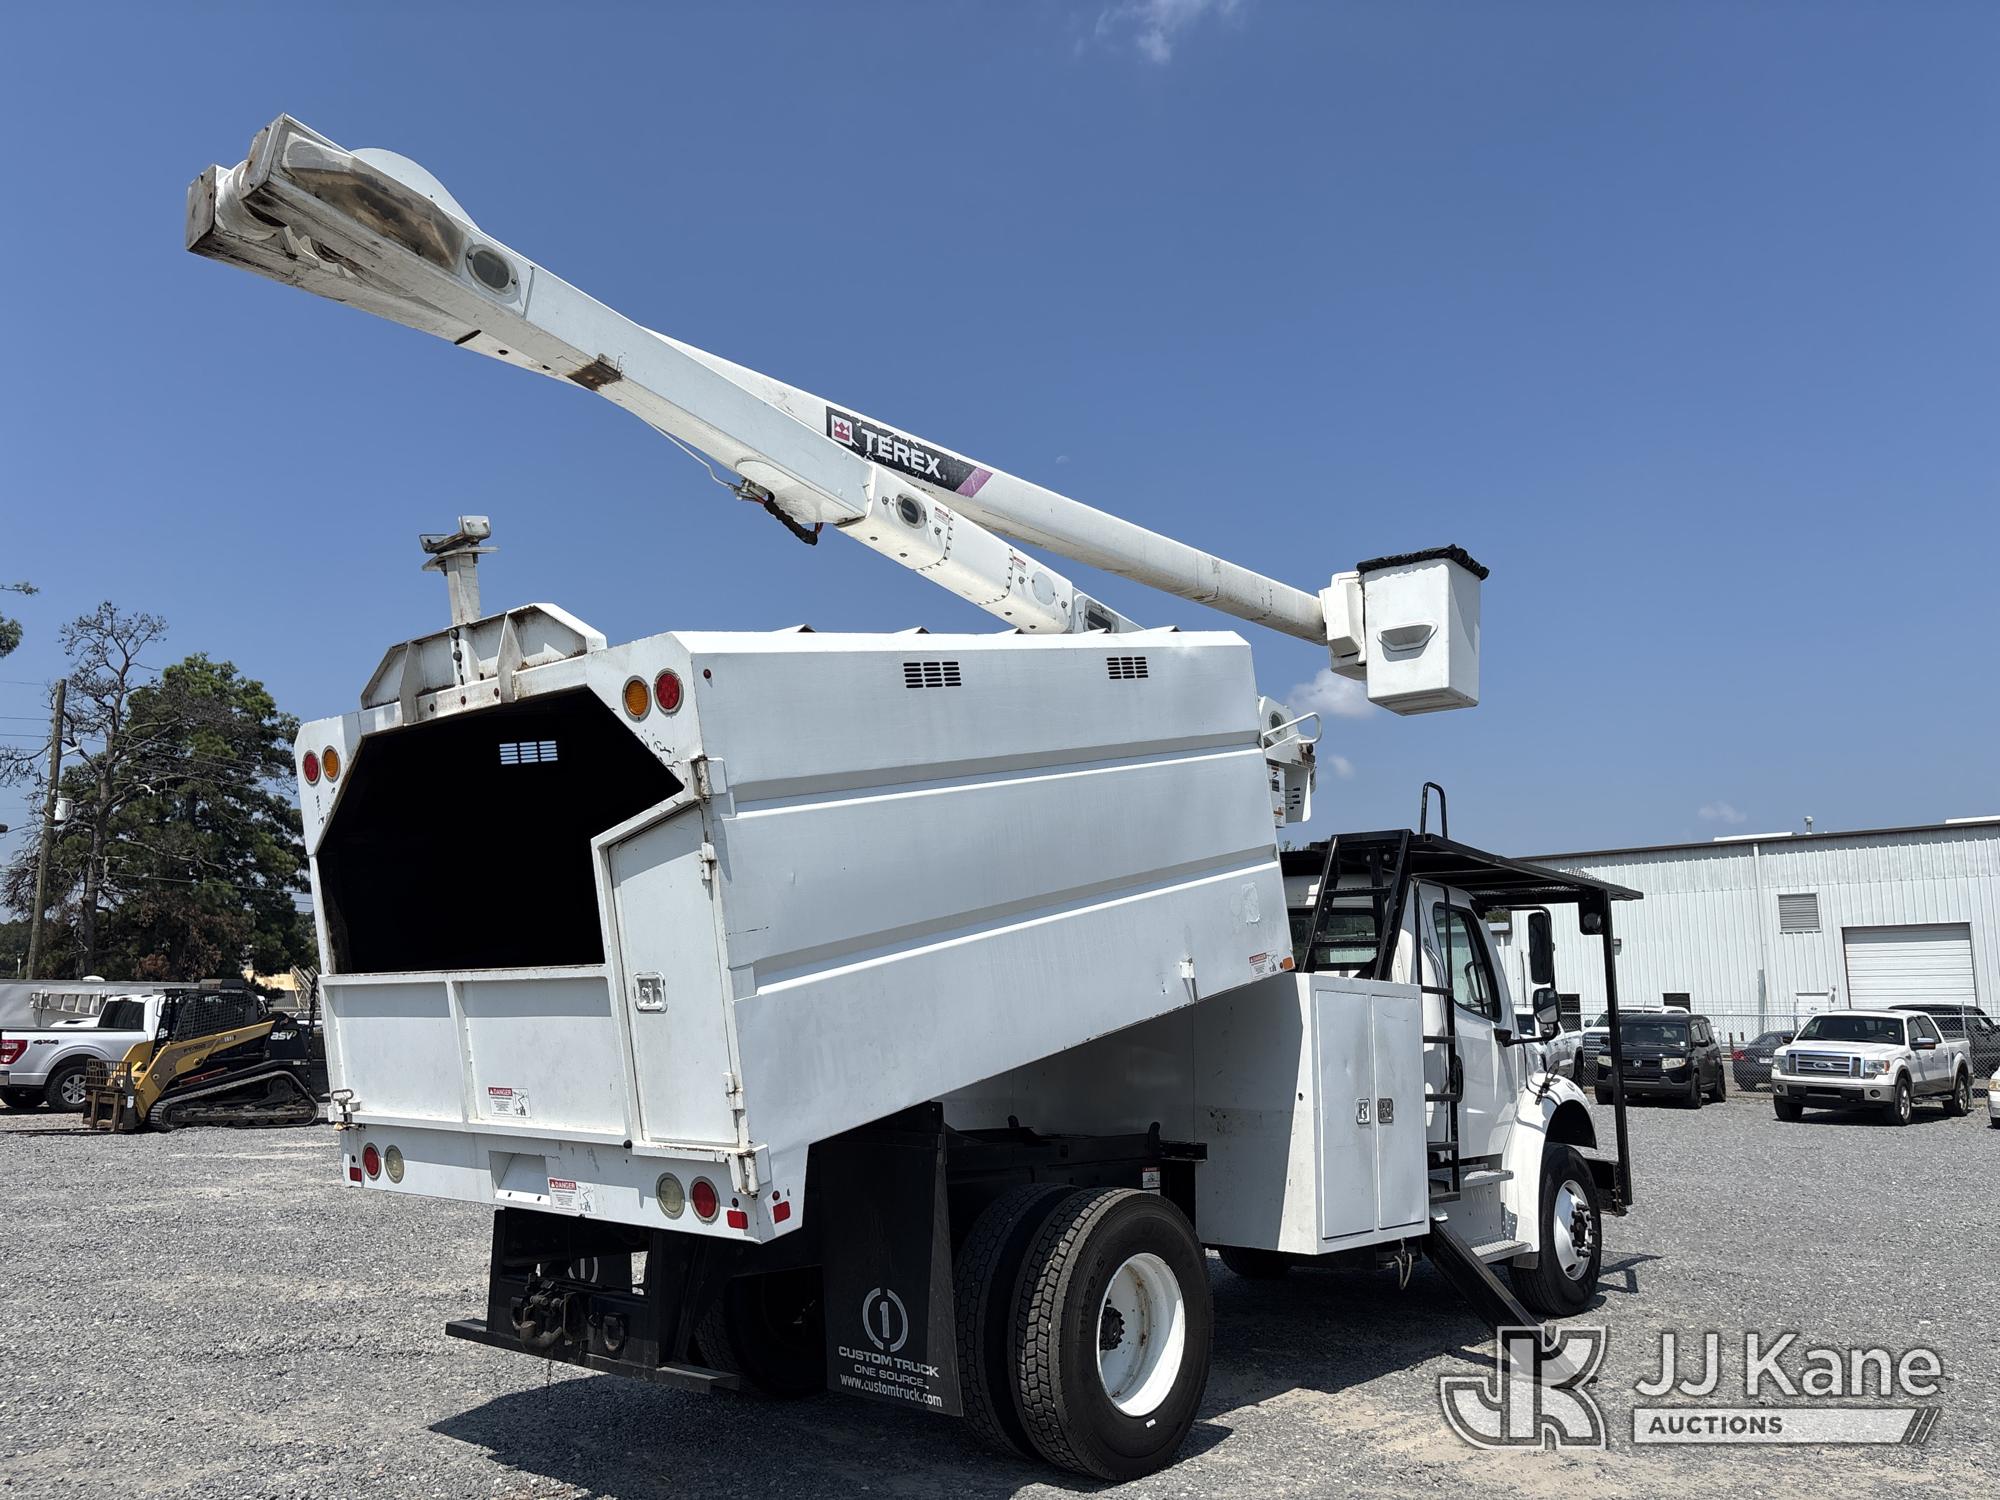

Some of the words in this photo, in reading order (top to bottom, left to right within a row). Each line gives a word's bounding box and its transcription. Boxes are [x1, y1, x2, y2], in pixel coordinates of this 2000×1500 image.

[861, 429, 942, 480] TEREX
[555, 1181, 576, 1190] DANGER
[838, 1346, 893, 1367] CUSTOM
[894, 1358, 940, 1377] TRUCK
[854, 1364, 877, 1377] ONE
[878, 1369, 924, 1388] SOURCE
[840, 1374, 943, 1408] www.customtruck.com
